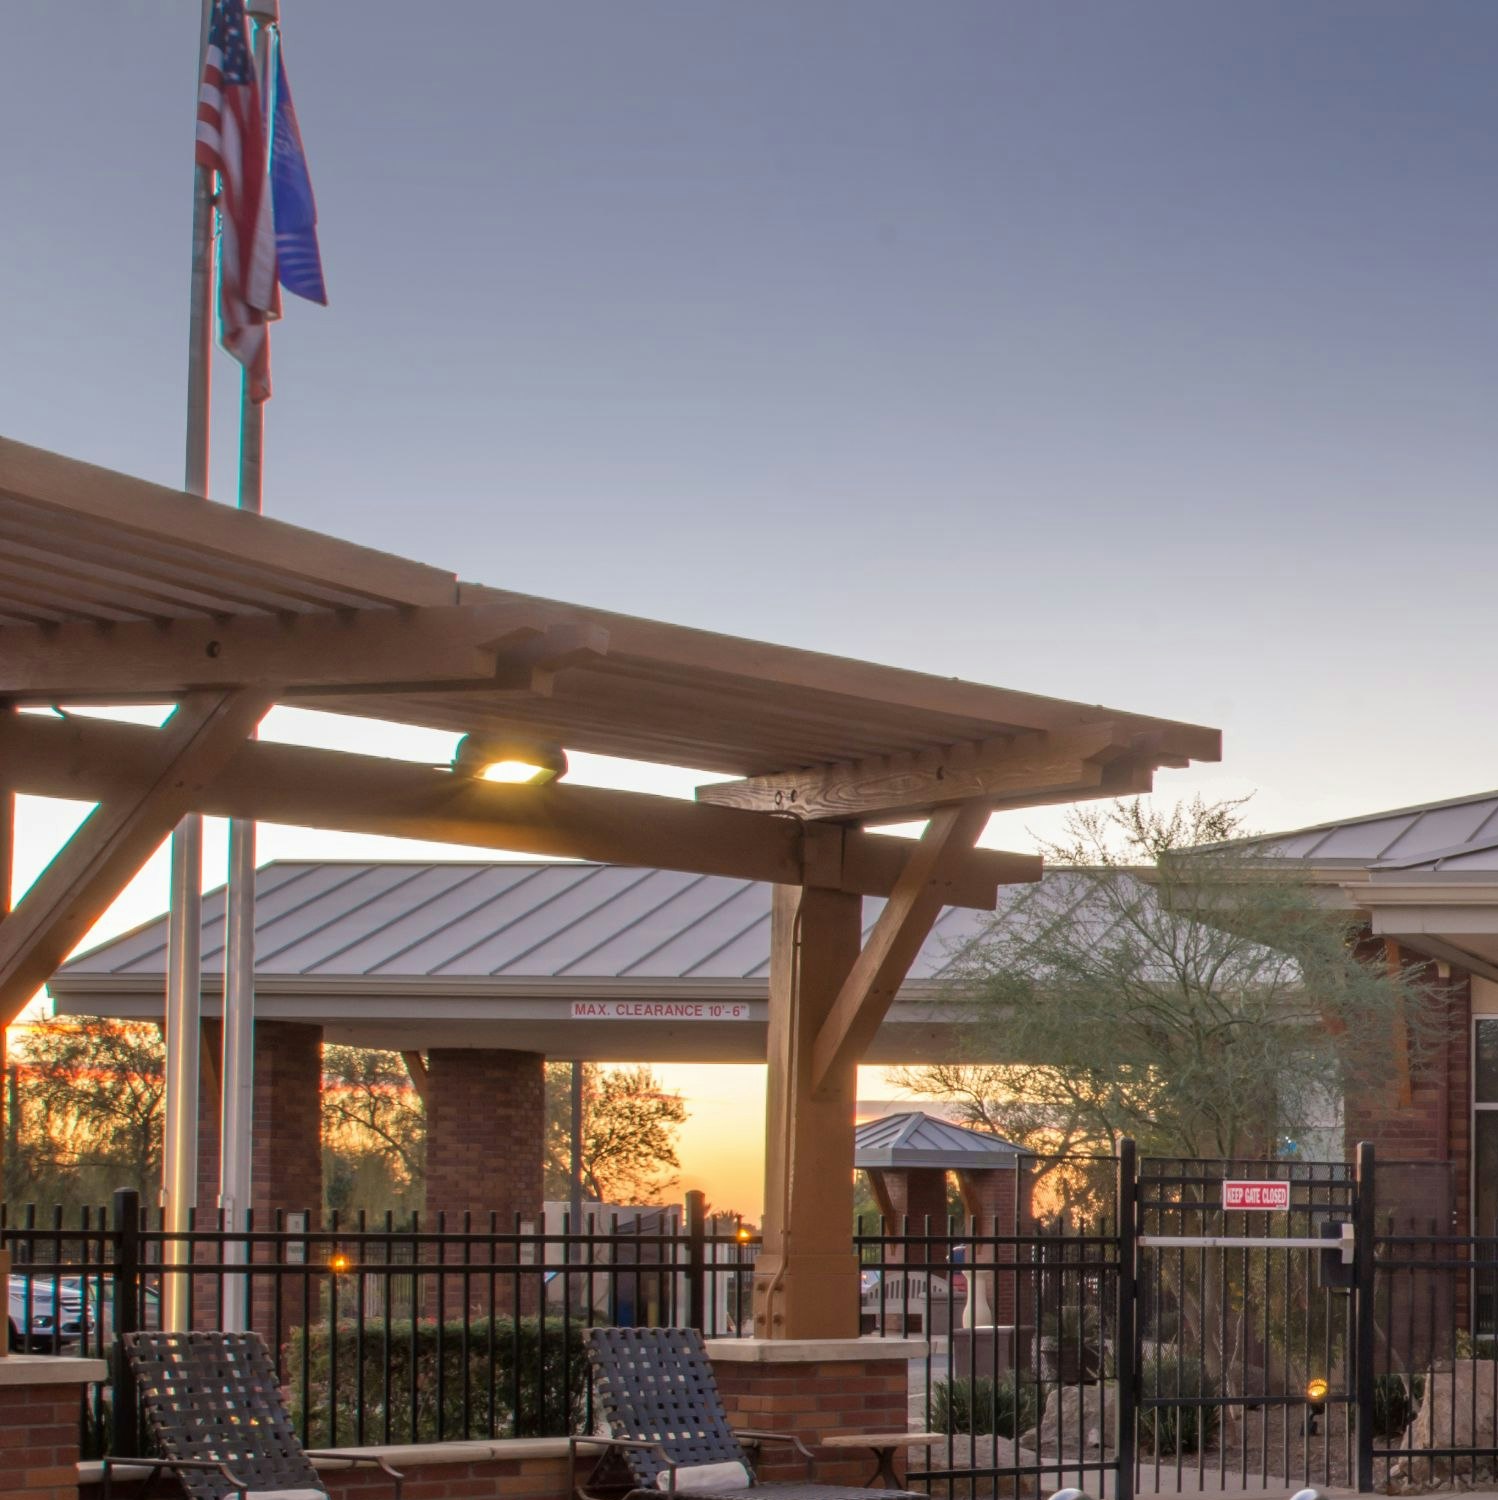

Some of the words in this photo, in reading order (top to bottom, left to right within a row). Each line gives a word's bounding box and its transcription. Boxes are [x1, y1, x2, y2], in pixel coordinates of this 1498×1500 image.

[575, 1003, 610, 1015] MAX.
[615, 1004, 703, 1016] CLEARANCE
[1227, 1187, 1243, 1203] KEEP
[1245, 1187, 1261, 1203] GATE
[1262, 1188, 1287, 1204] CLOSED
